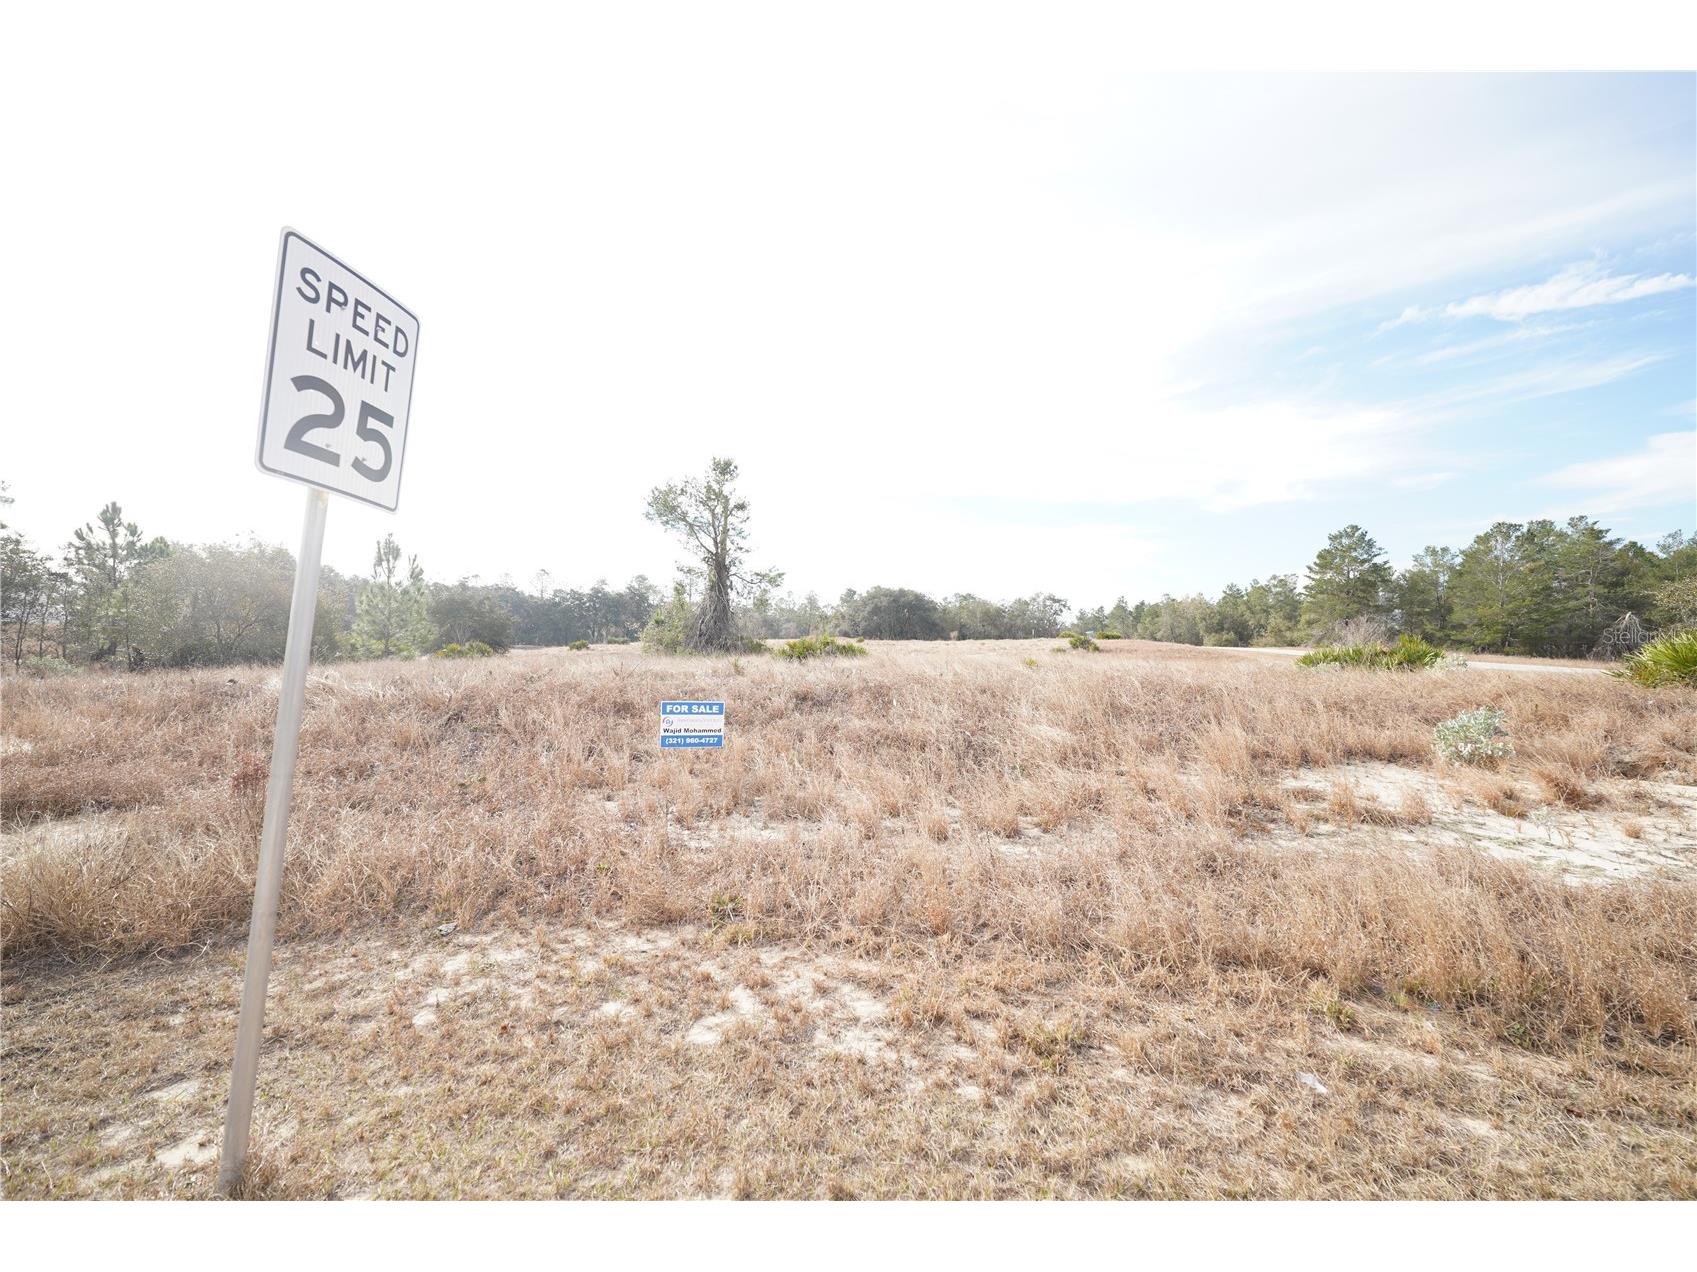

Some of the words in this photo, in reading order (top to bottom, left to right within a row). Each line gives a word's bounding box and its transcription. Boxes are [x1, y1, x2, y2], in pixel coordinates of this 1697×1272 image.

[296, 266, 409, 358] SPEED
[306, 318, 396, 393] LIMIT
[283, 374, 395, 484] 25
[666, 705, 689, 713] FOR
[691, 705, 719, 713] SALE
